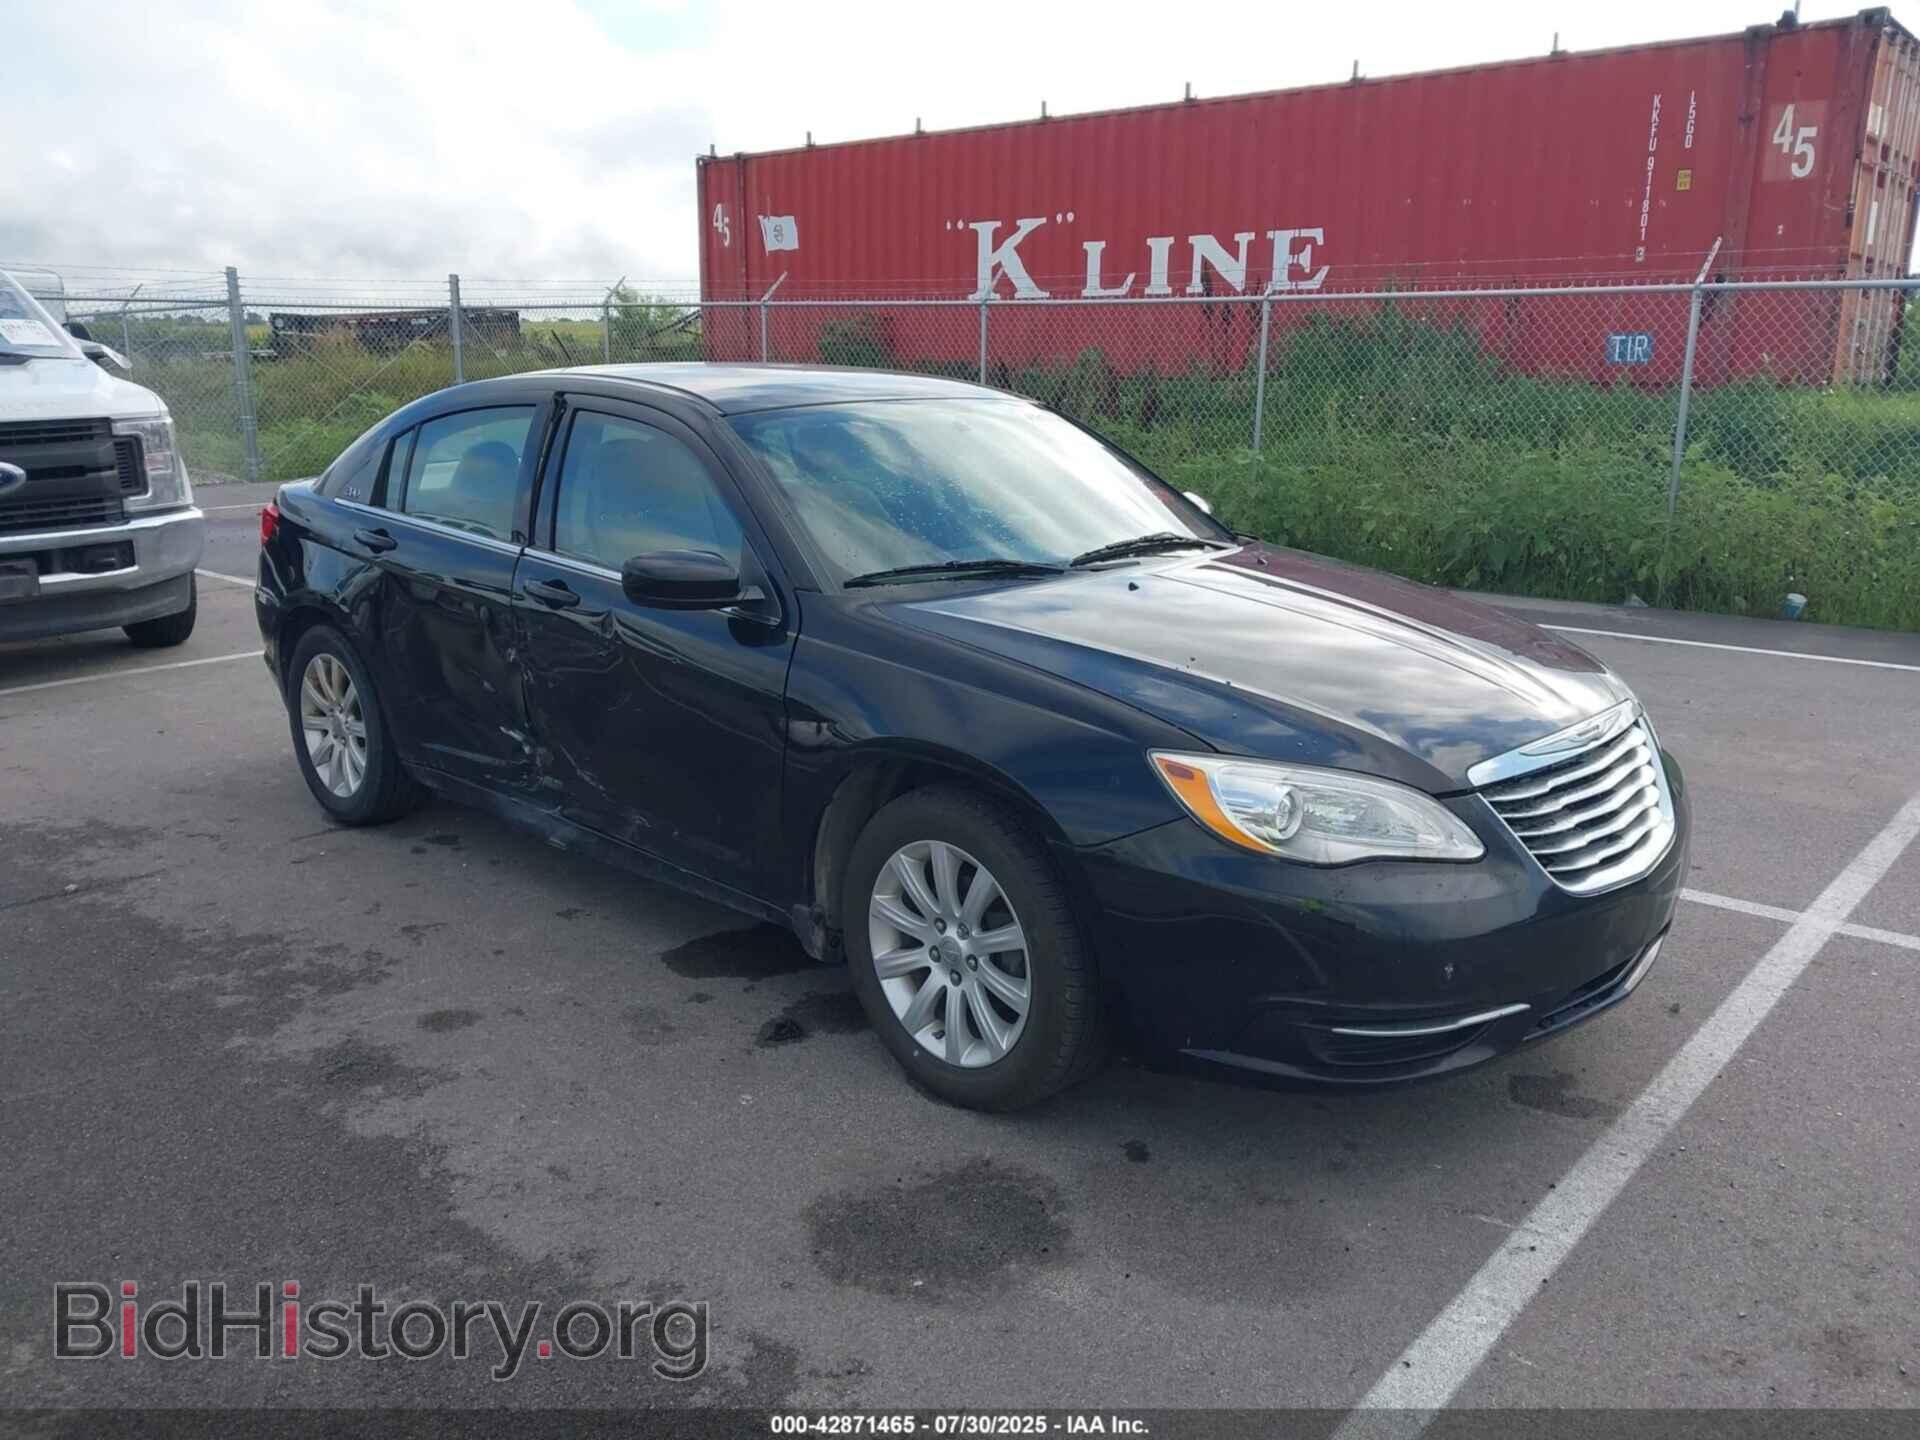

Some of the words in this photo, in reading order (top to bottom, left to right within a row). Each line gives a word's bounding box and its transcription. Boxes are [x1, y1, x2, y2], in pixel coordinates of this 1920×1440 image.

[1649, 94, 1661, 151] KKFU
[1772, 104, 1818, 178] 45
[713, 203, 730, 247] 45
[1640, 156, 1655, 241] 911801
[1081, 227, 1331, 298] LINE
[1610, 335, 1648, 361] TIR
